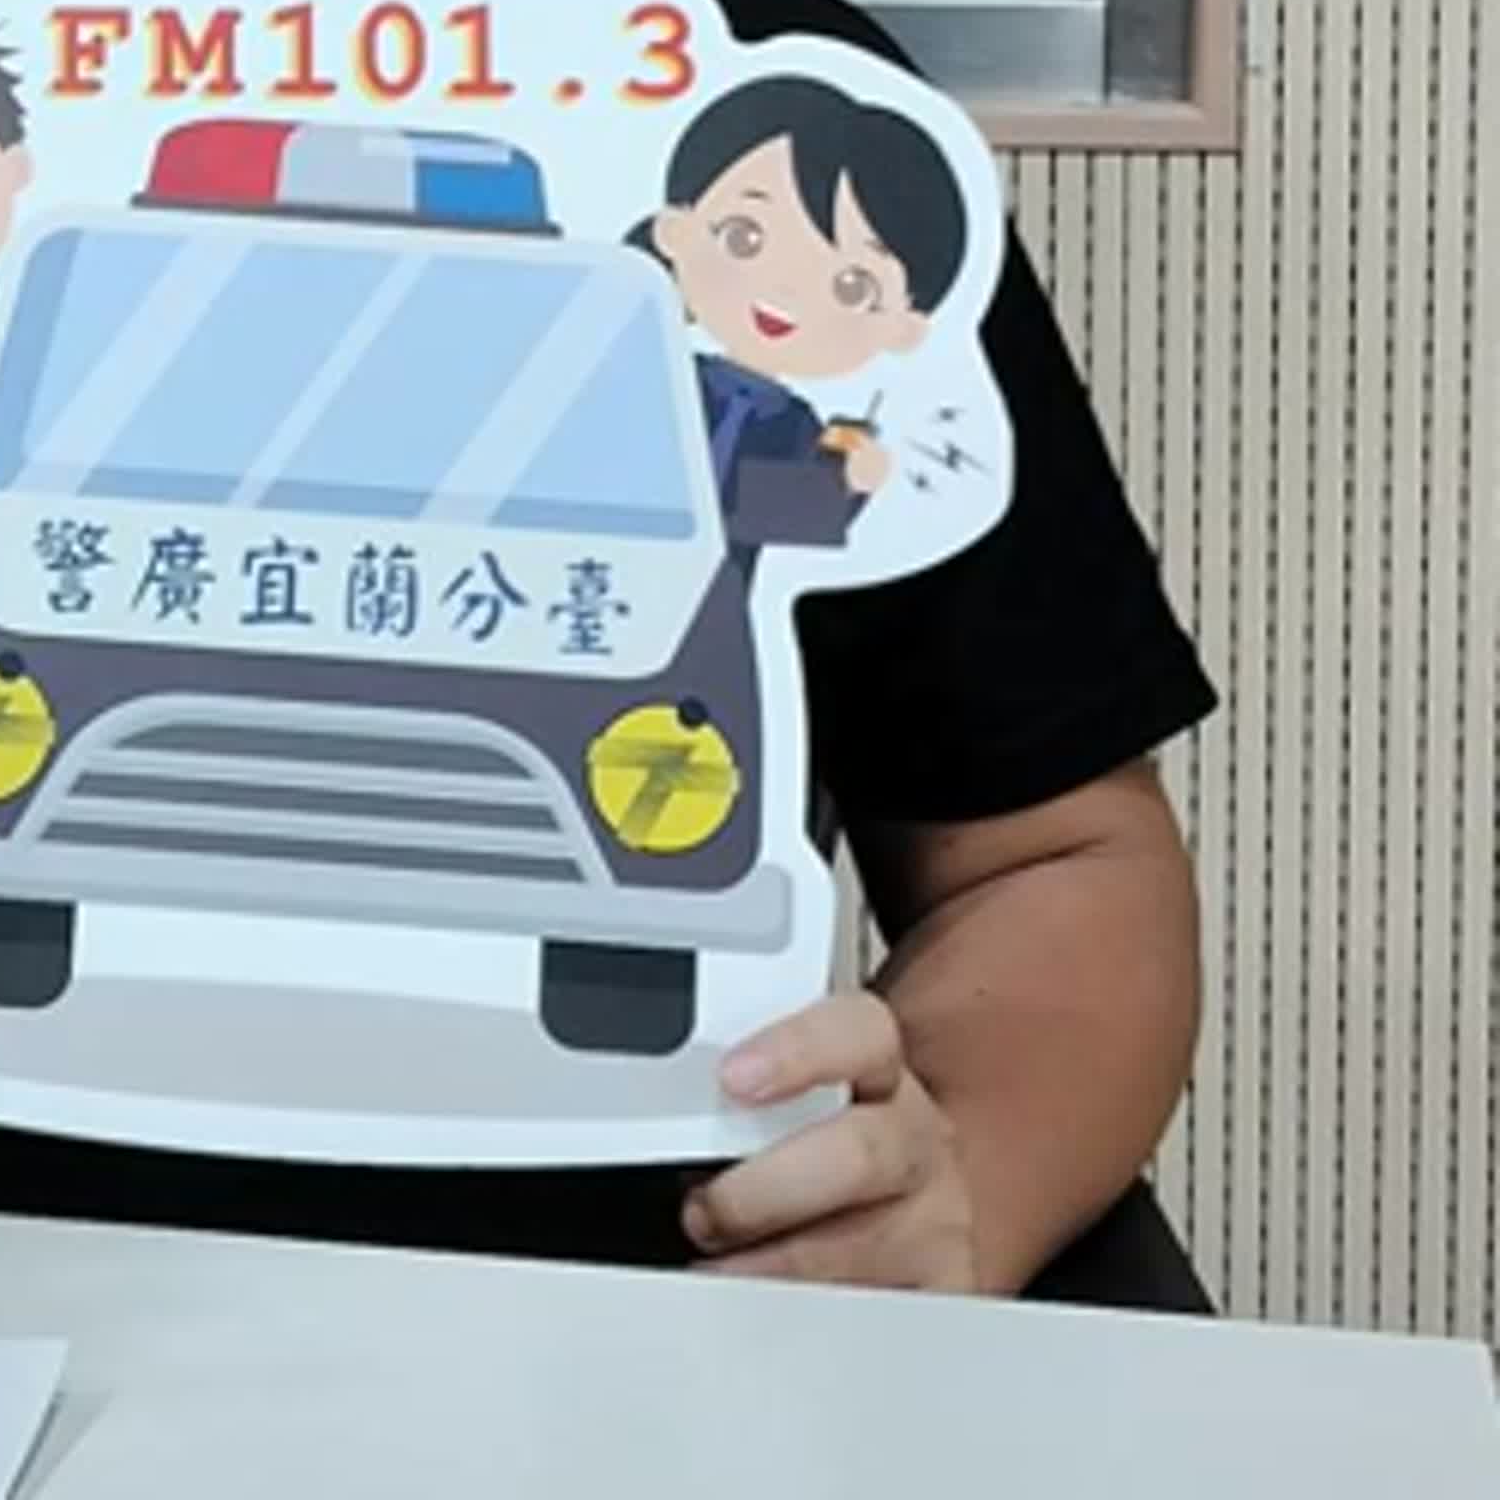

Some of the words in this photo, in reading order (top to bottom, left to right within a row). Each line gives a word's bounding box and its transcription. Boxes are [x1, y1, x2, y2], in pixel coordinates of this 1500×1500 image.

[47, 0, 699, 101] FM101.3
[33, 518, 632, 658] 警廣宜蘭分臺
